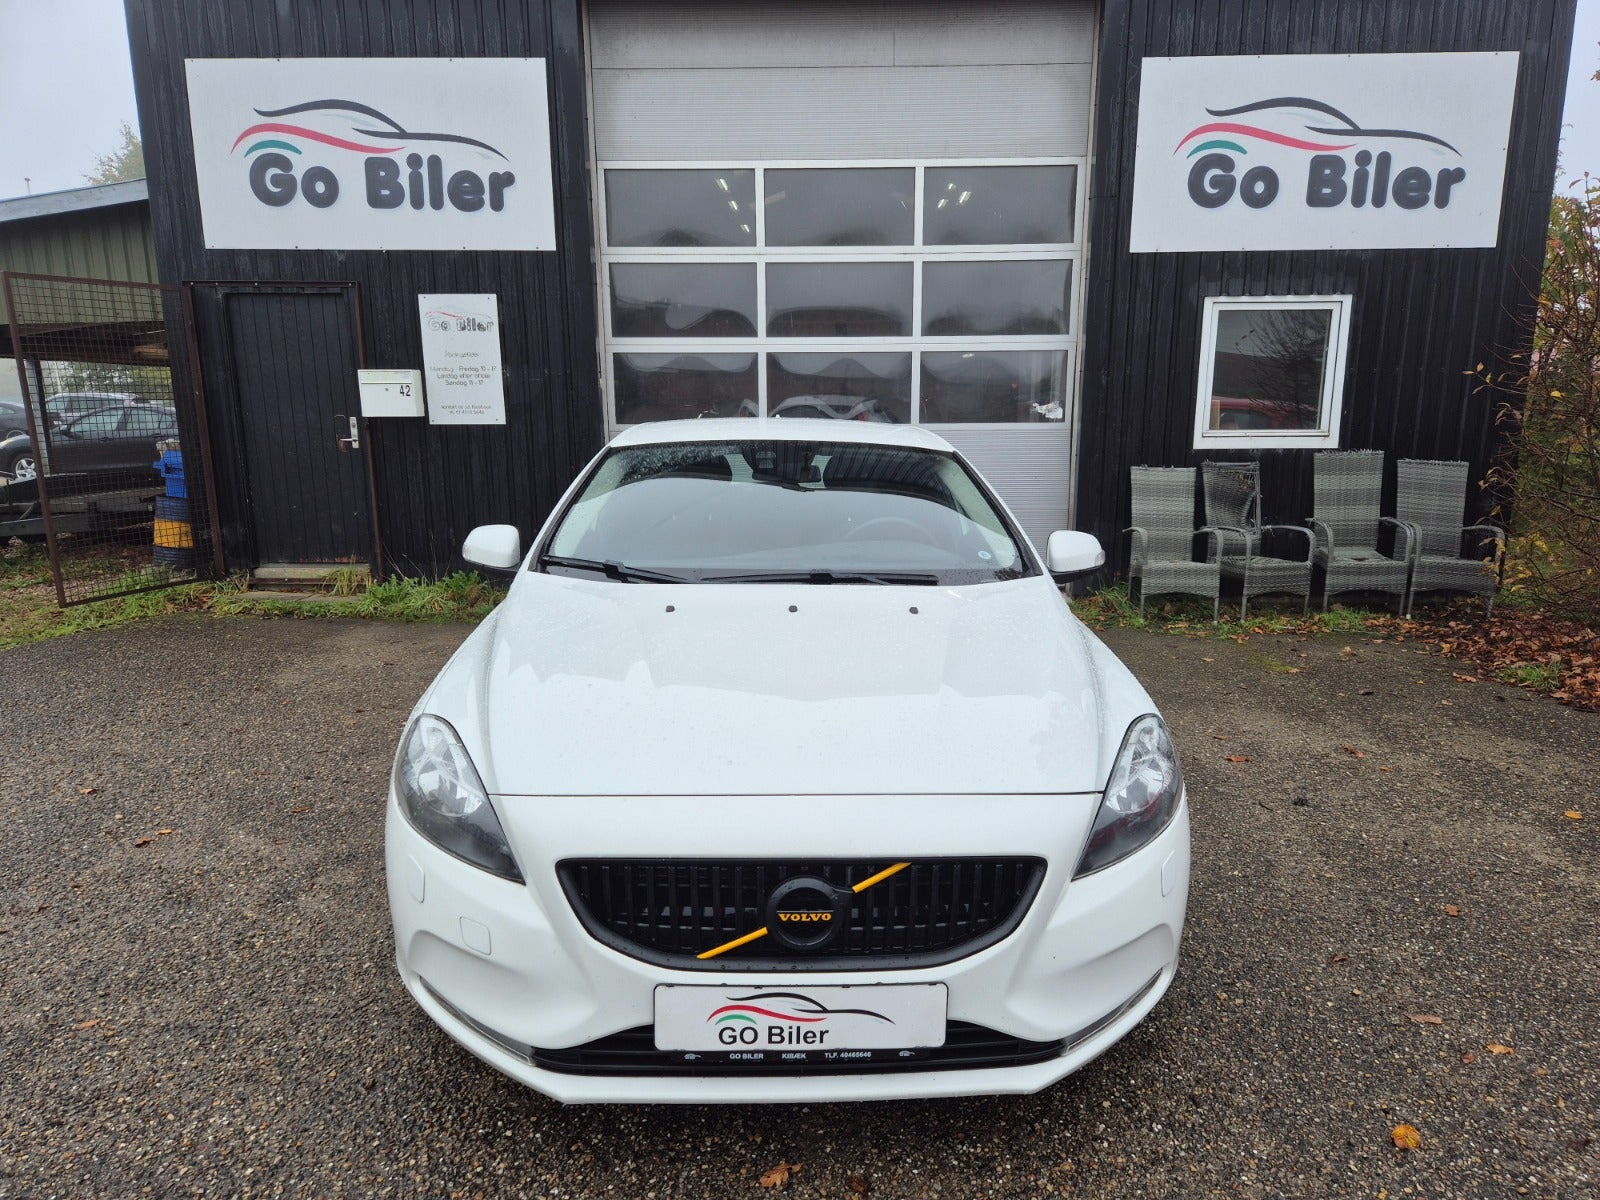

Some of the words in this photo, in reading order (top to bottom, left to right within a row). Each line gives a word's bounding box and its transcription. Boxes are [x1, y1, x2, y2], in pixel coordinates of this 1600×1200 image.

[249, 152, 339, 208] Go
[364, 152, 516, 212] Biler
[1187, 152, 1279, 209] Go
[1306, 149, 1466, 210] Biler
[399, 384, 411, 397] 42
[778, 912, 832, 922] VOLVO
[718, 1026, 758, 1045] GO
[767, 1025, 829, 1045] Biler
[729, 1052, 741, 1060] GO
[742, 1052, 764, 1060] BILER
